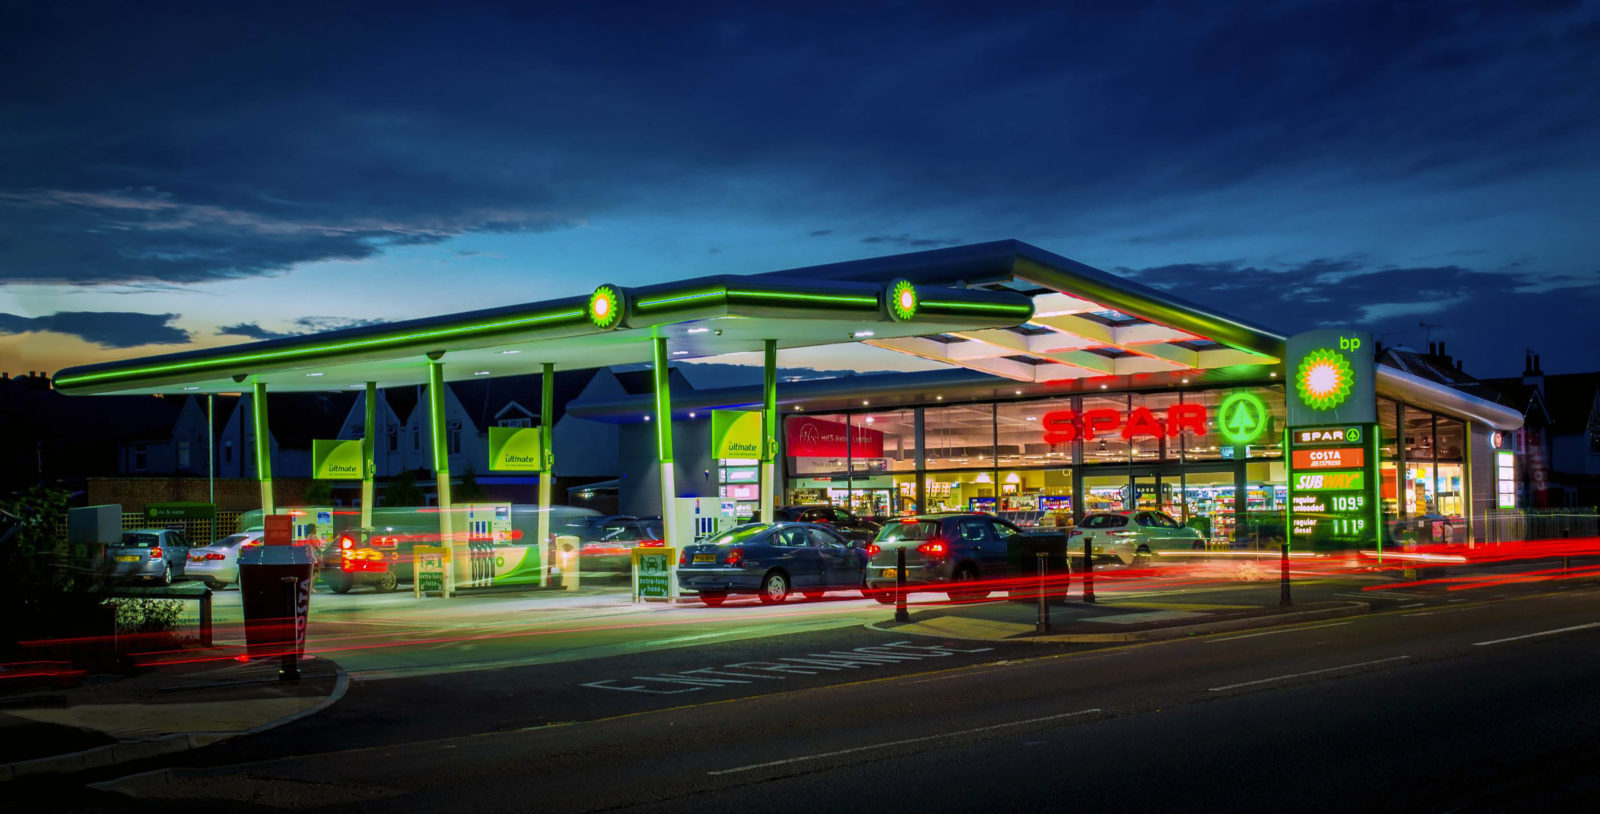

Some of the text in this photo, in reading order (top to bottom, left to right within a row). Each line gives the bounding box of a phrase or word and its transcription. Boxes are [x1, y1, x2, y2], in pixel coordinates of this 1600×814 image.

[1340, 336, 1360, 352] bp
[1043, 404, 1207, 444] SPAR
[1302, 431, 1343, 441] SPAR
[728, 443, 757, 451] ultimate
[505, 455, 534, 463] ultimate
[1310, 450, 1341, 461] COSTA
[1296, 473, 1358, 490] SUBWAY
[1293, 496, 1316, 505] regular
[1293, 518, 1317, 527] regular
[1294, 526, 1312, 534] diesel
[640, 577, 668, 586] extra-long
[581, 640, 996, 695] ENTRANCE
